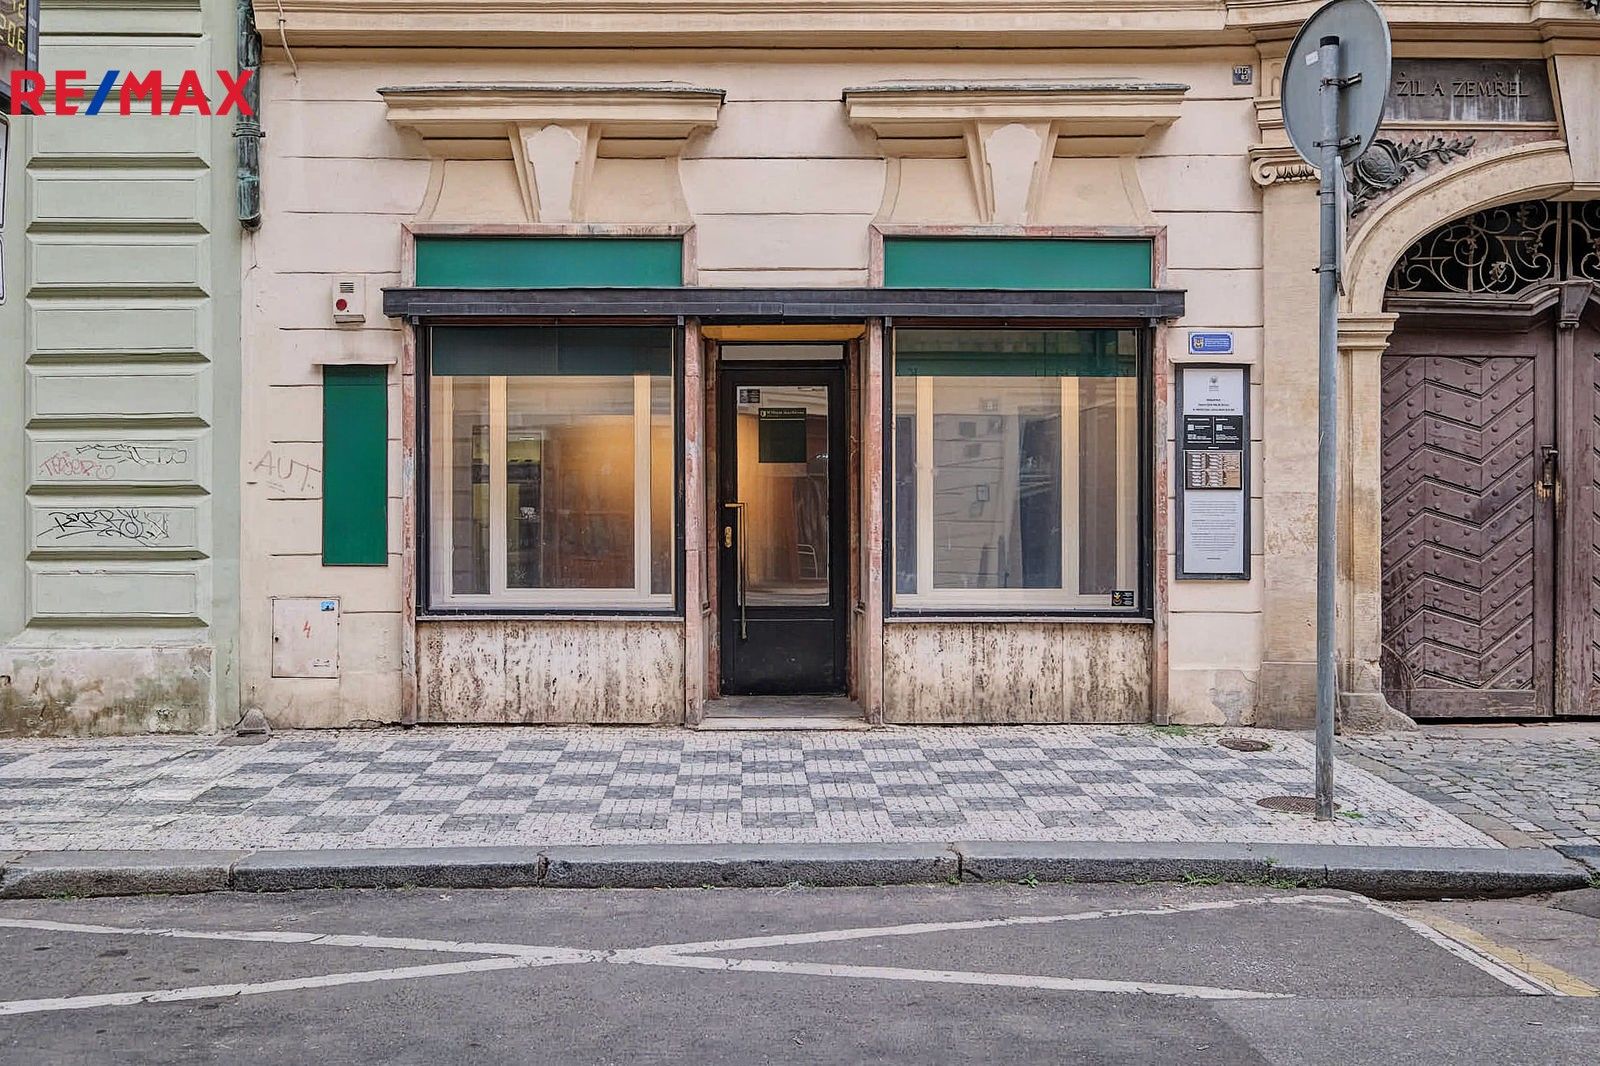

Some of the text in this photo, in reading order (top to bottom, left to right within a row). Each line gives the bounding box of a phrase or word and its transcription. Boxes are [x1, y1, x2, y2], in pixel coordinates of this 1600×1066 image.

[1396, 71, 1529, 98] ŽIL A ZEMŘEL
